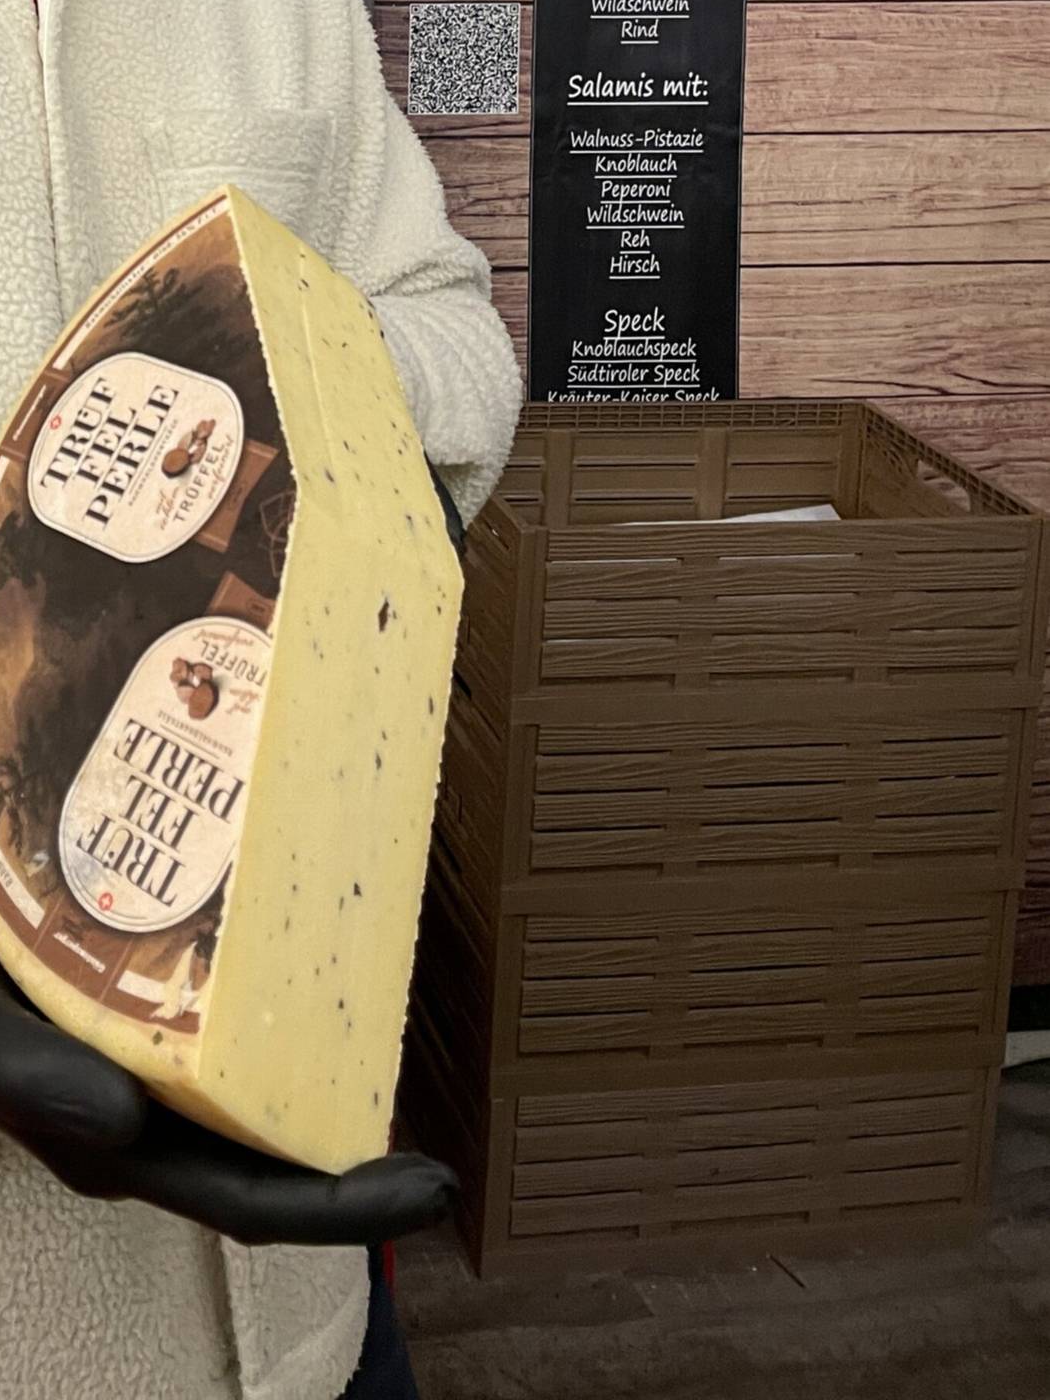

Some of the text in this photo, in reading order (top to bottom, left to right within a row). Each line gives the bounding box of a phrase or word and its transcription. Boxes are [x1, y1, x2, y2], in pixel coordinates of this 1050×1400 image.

[621, 19, 659, 38] Rind
[568, 71, 708, 98] Salamis mit:
[570, 128, 704, 148] Walnuss-Pistazie
[595, 153, 677, 173] Knoblauch
[601, 179, 672, 202] Peperoni
[586, 204, 685, 223] Wildschwein
[621, 229, 650, 248] Reh
[610, 254, 660, 273] Hirsch
[604, 306, 665, 338] Speck
[572, 337, 697, 360] Knoblauchspeck
[567, 363, 700, 386] Südtiroler Speck
[41, 377, 117, 489] TRÜF
[74, 407, 137, 487] FEL
[83, 385, 180, 529] PERLE
[174, 442, 226, 522] TRÜFFEL
[200, 640, 268, 687] TRÜFFEL
[113, 717, 246, 824] PERLE
[119, 774, 199, 854] FEL
[76, 814, 187, 909] TRÜF
